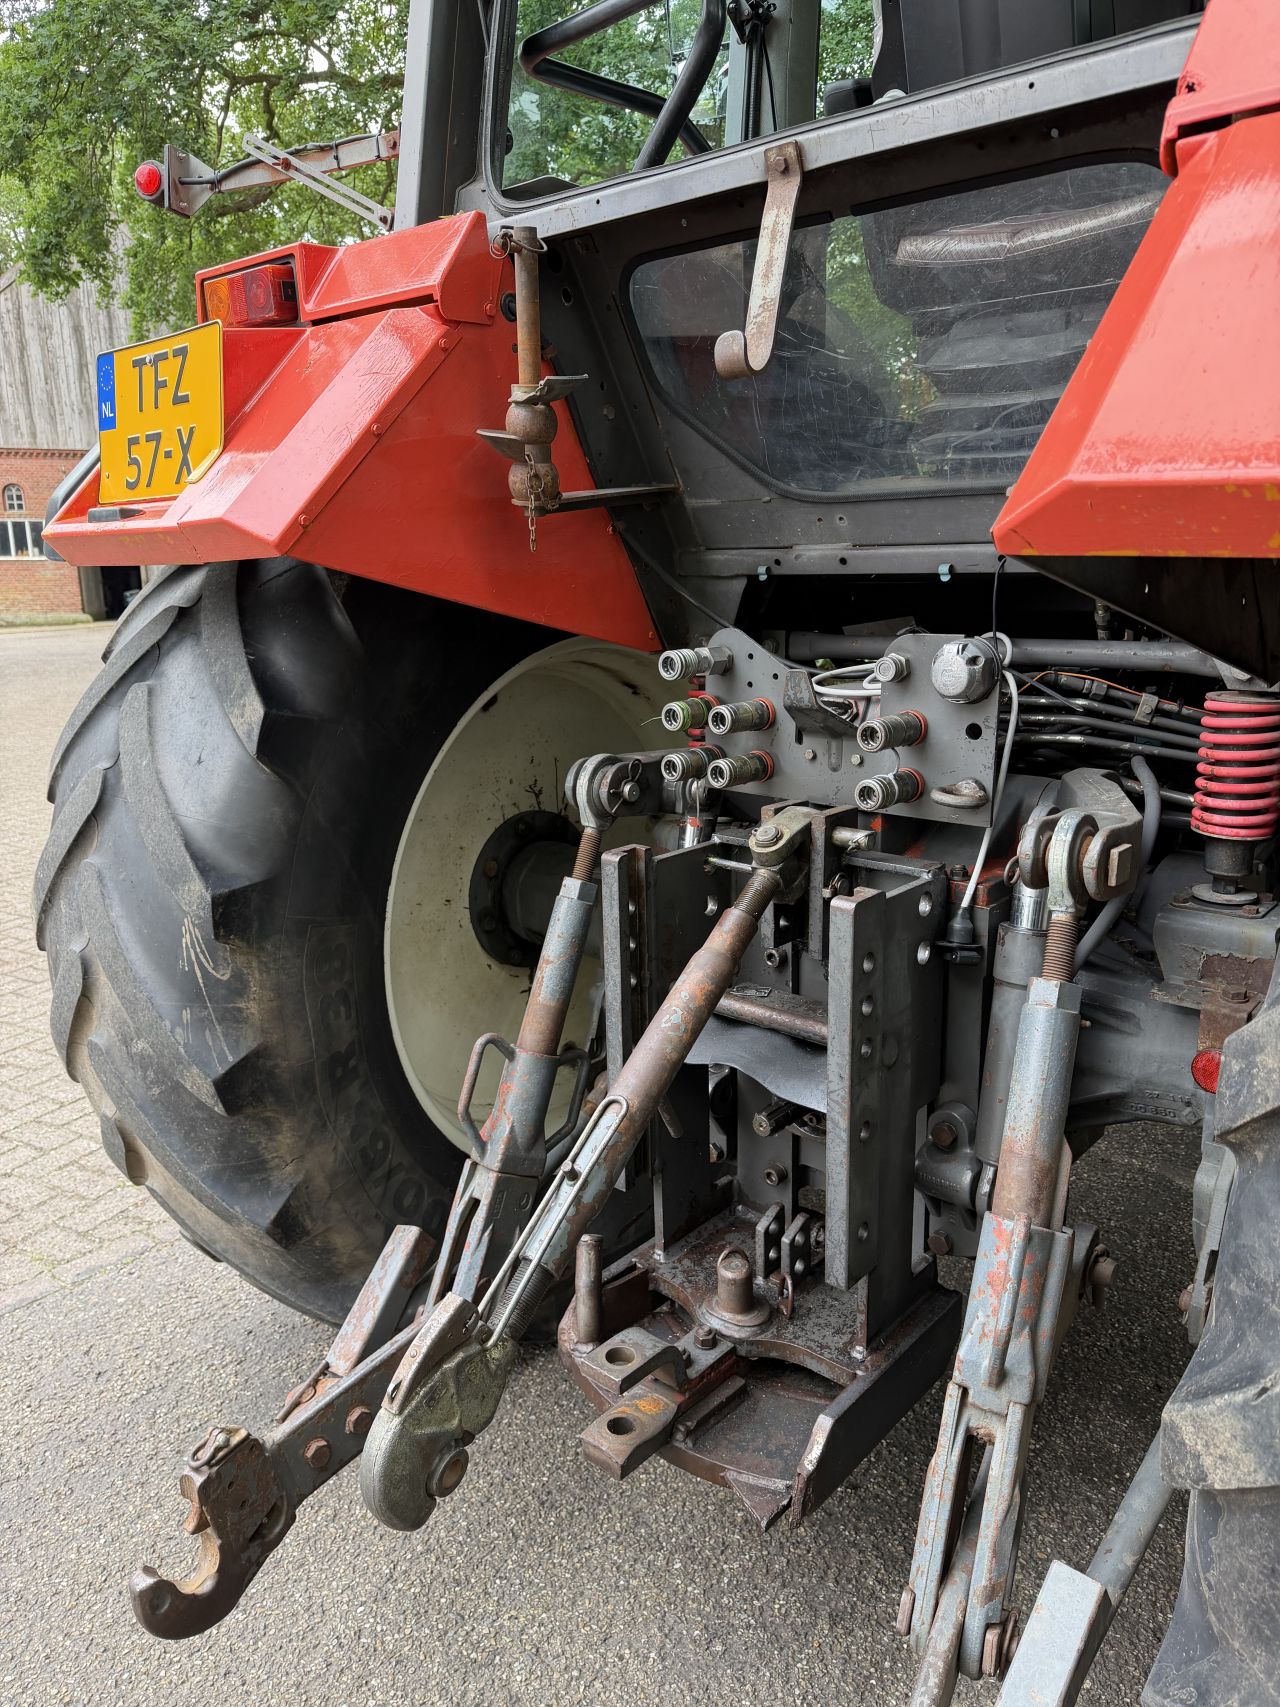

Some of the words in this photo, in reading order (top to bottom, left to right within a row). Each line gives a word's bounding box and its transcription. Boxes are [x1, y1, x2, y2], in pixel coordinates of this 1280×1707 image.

[102, 401, 114, 418] NL
[132, 343, 190, 412] TFZ
[126, 424, 196, 490] 57-X
